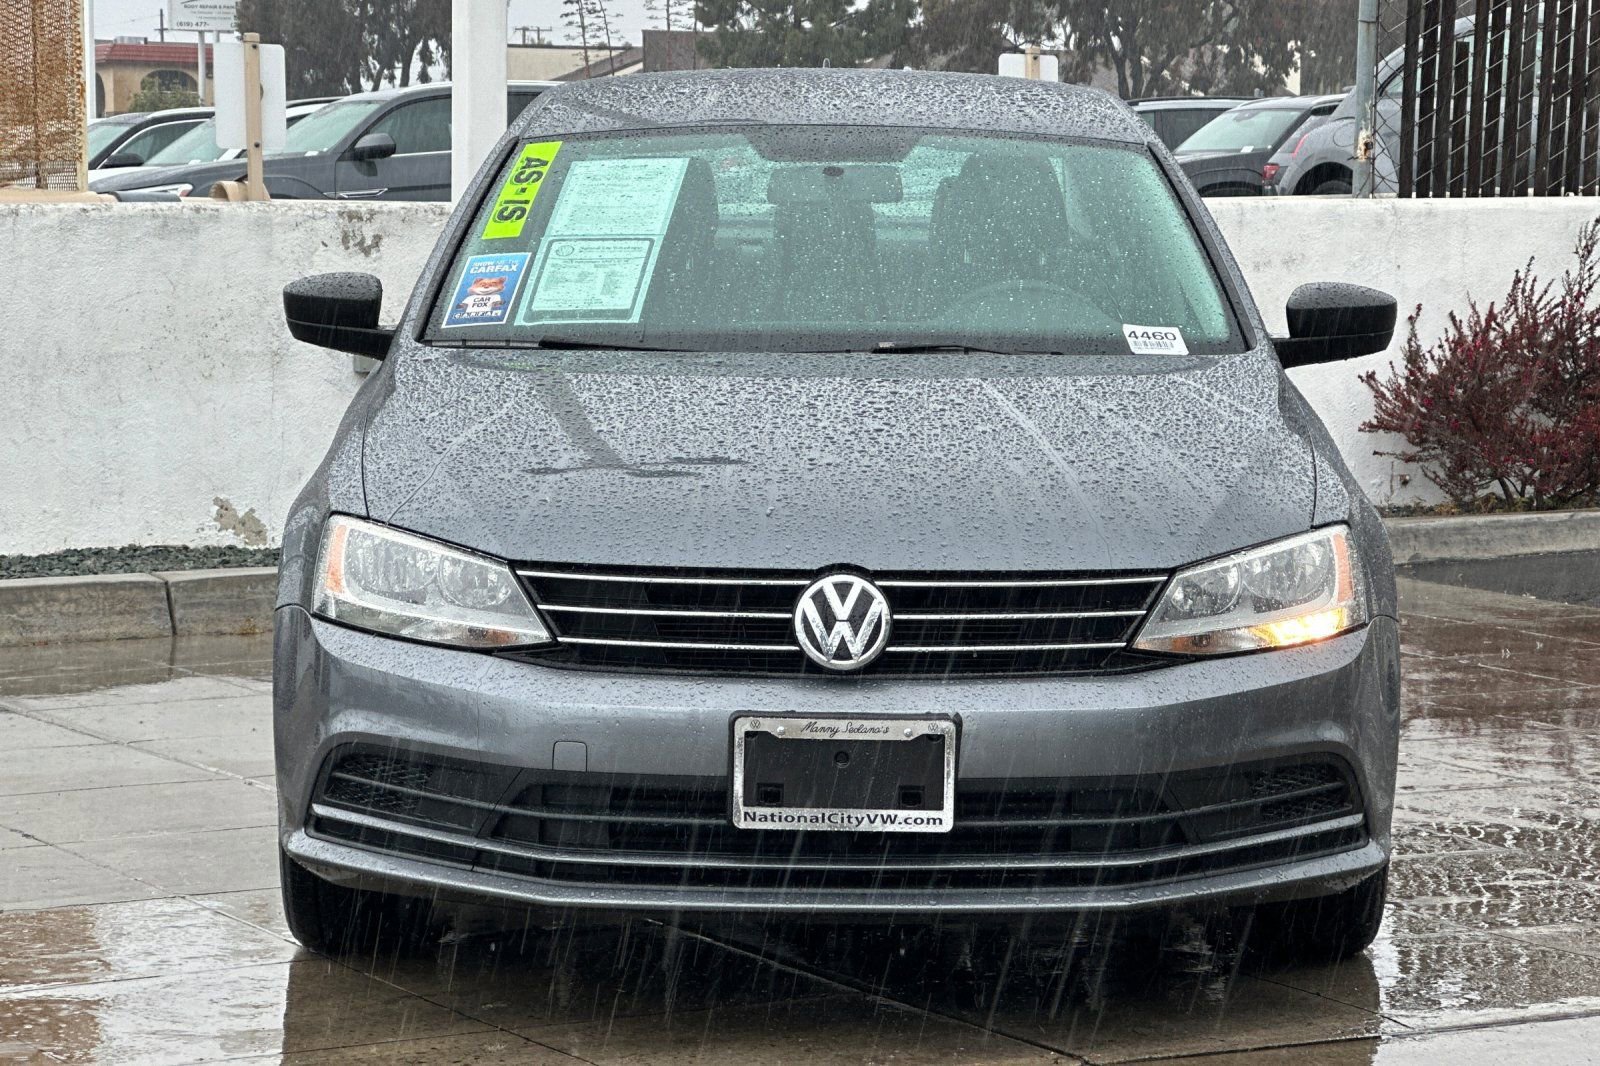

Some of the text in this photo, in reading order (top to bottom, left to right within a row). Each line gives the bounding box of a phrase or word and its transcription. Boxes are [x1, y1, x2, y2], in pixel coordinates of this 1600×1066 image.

[495, 157, 549, 222] AS-IS
[470, 263, 518, 274] CARFAX
[1128, 331, 1177, 341] 4460
[801, 721, 840, 738] Manny
[743, 811, 943, 827] NationalCityVW.com
